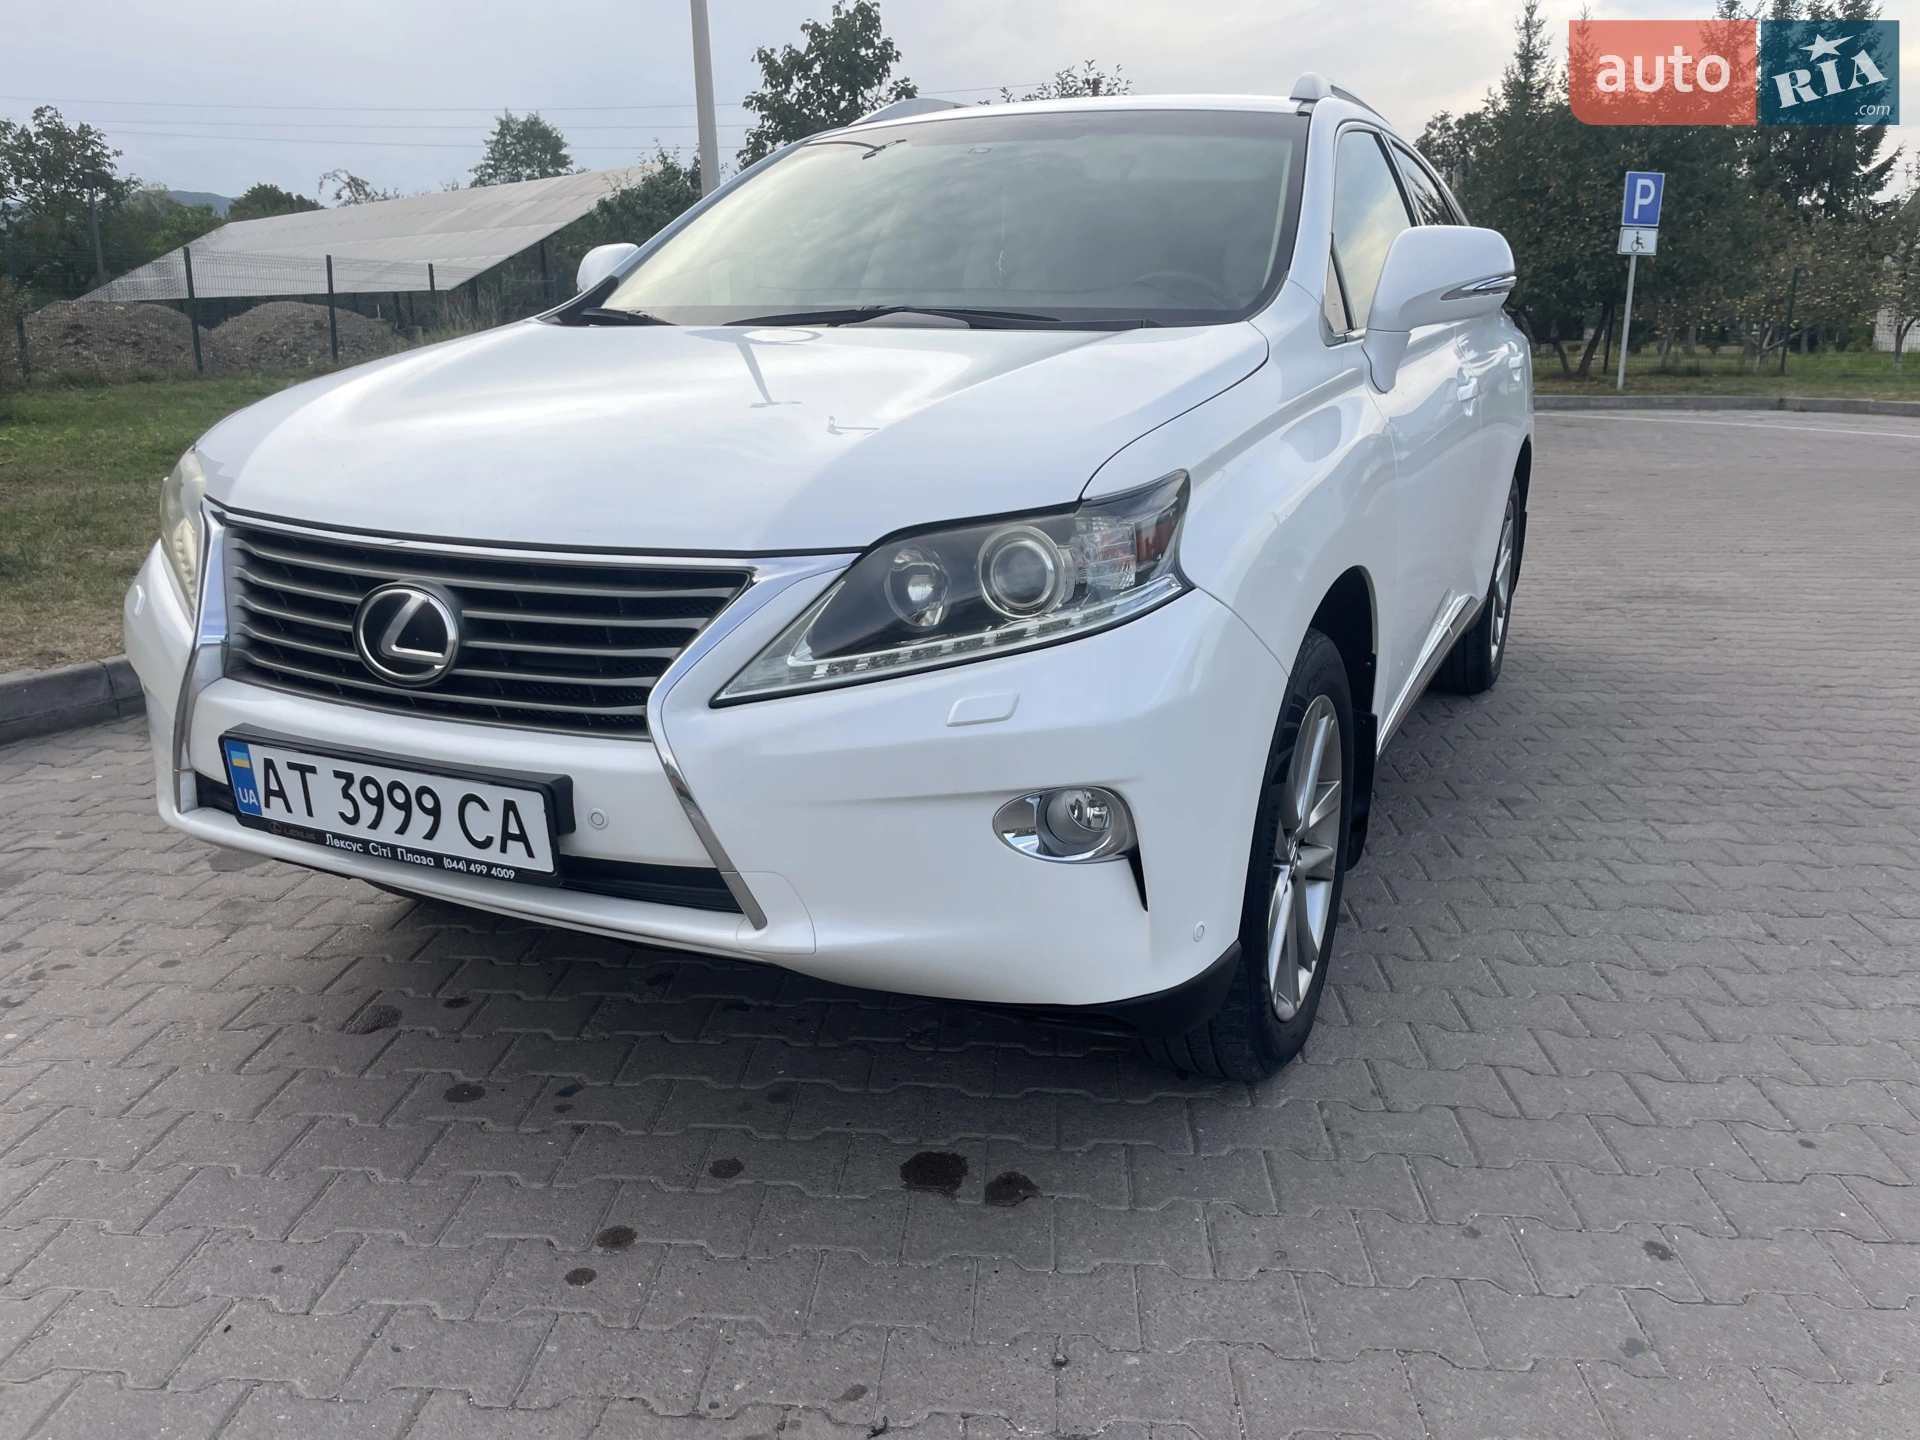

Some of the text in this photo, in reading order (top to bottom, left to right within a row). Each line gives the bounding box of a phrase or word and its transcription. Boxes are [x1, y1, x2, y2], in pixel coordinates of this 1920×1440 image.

[1632, 178, 1656, 220] P
[238, 787, 259, 806] UA
[264, 757, 536, 859] AT 3999 CA
[325, 833, 515, 880] Лексус Сіті Плаза (044) 499 4009
